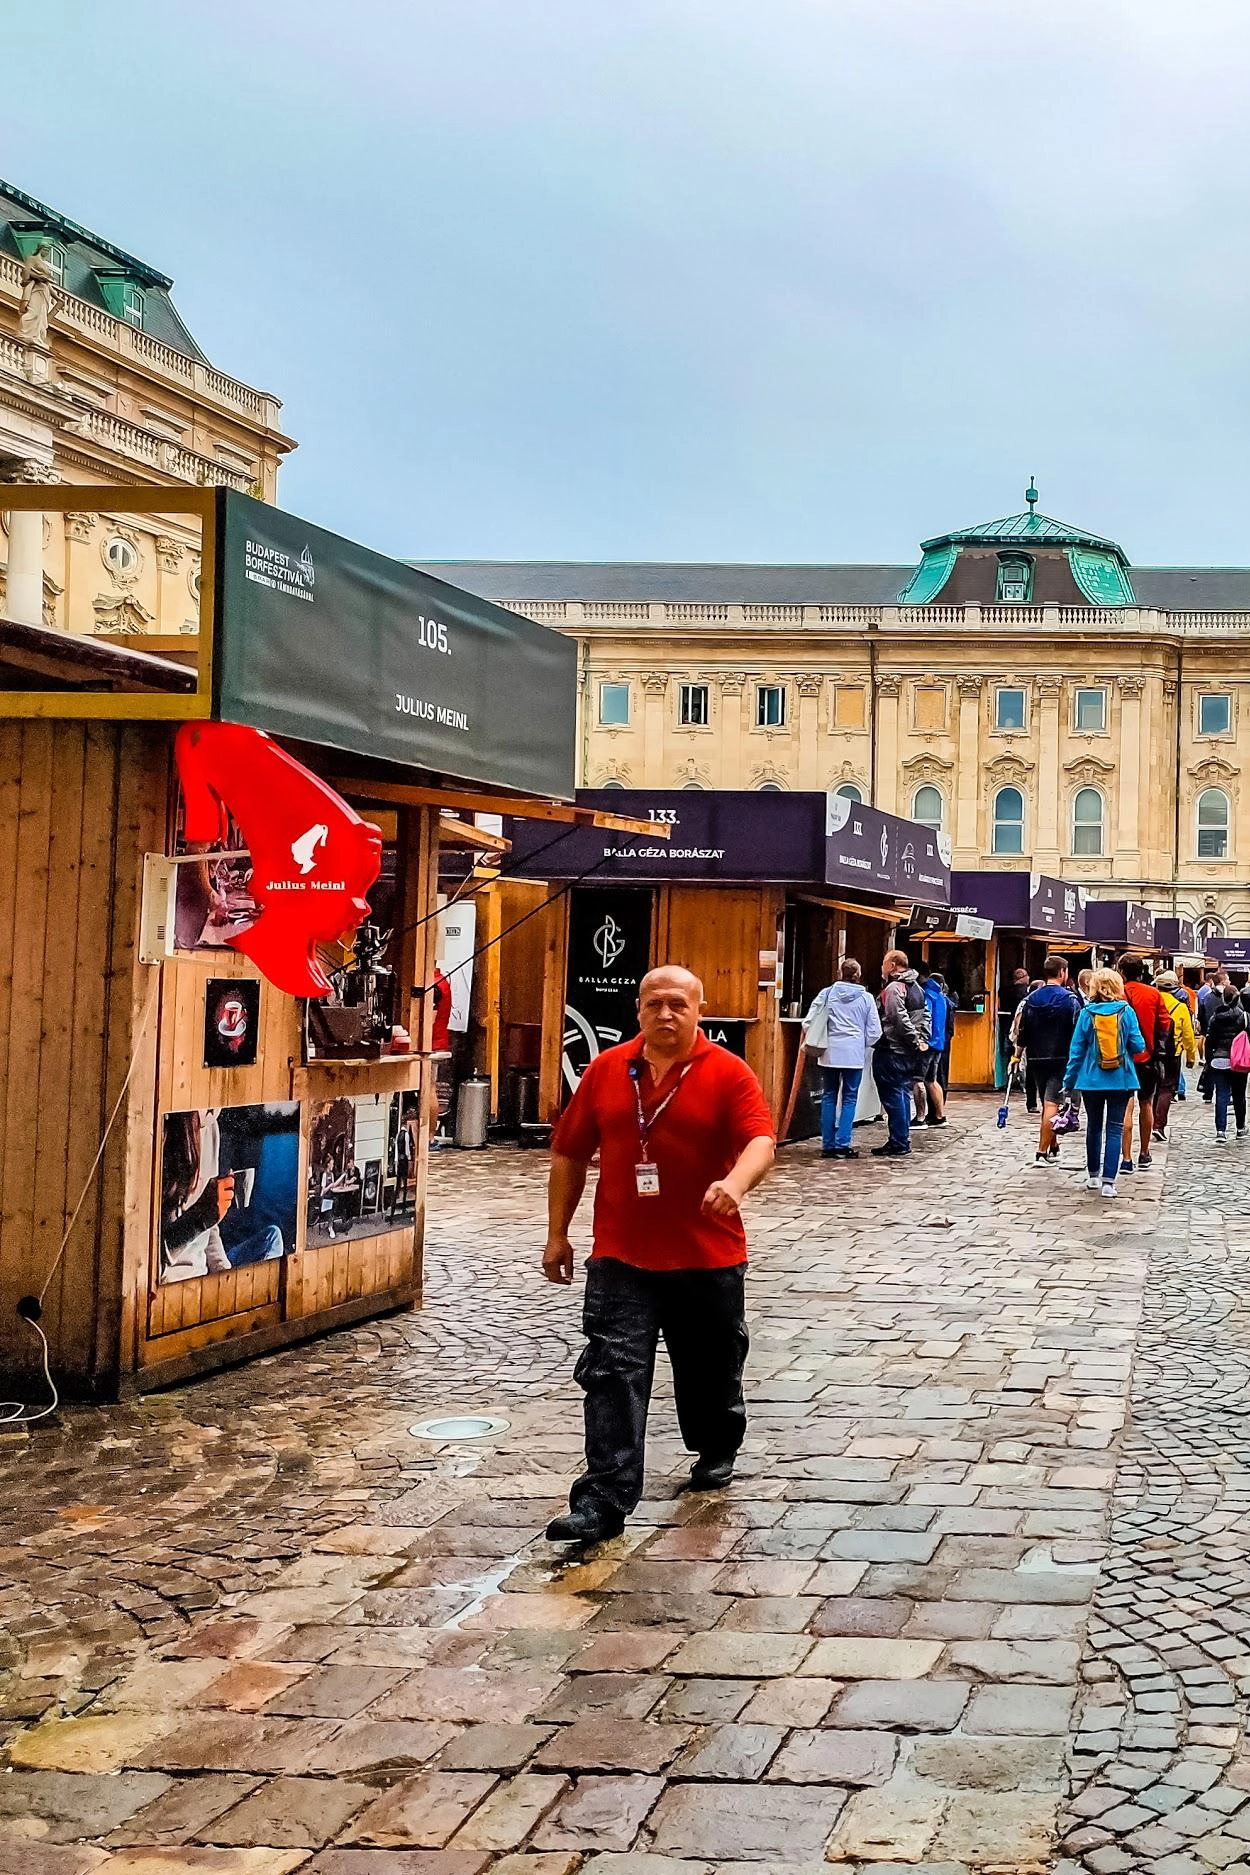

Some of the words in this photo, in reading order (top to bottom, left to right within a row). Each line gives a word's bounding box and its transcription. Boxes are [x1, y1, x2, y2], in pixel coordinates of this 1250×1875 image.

[246, 540, 290, 567] BUDAPEST
[246, 554, 305, 587] BORFESZTIVÁL
[418, 615, 452, 655] 105.
[395, 694, 434, 720] JULIUS
[436, 706, 469, 731] MEINL
[648, 809, 681, 825] 133.
[603, 847, 637, 858] BALLA
[638, 846, 668, 858] GÉZA
[669, 846, 726, 859] BORÁSZAT
[266, 881, 306, 890] Julius
[310, 881, 346, 891] Meinl
